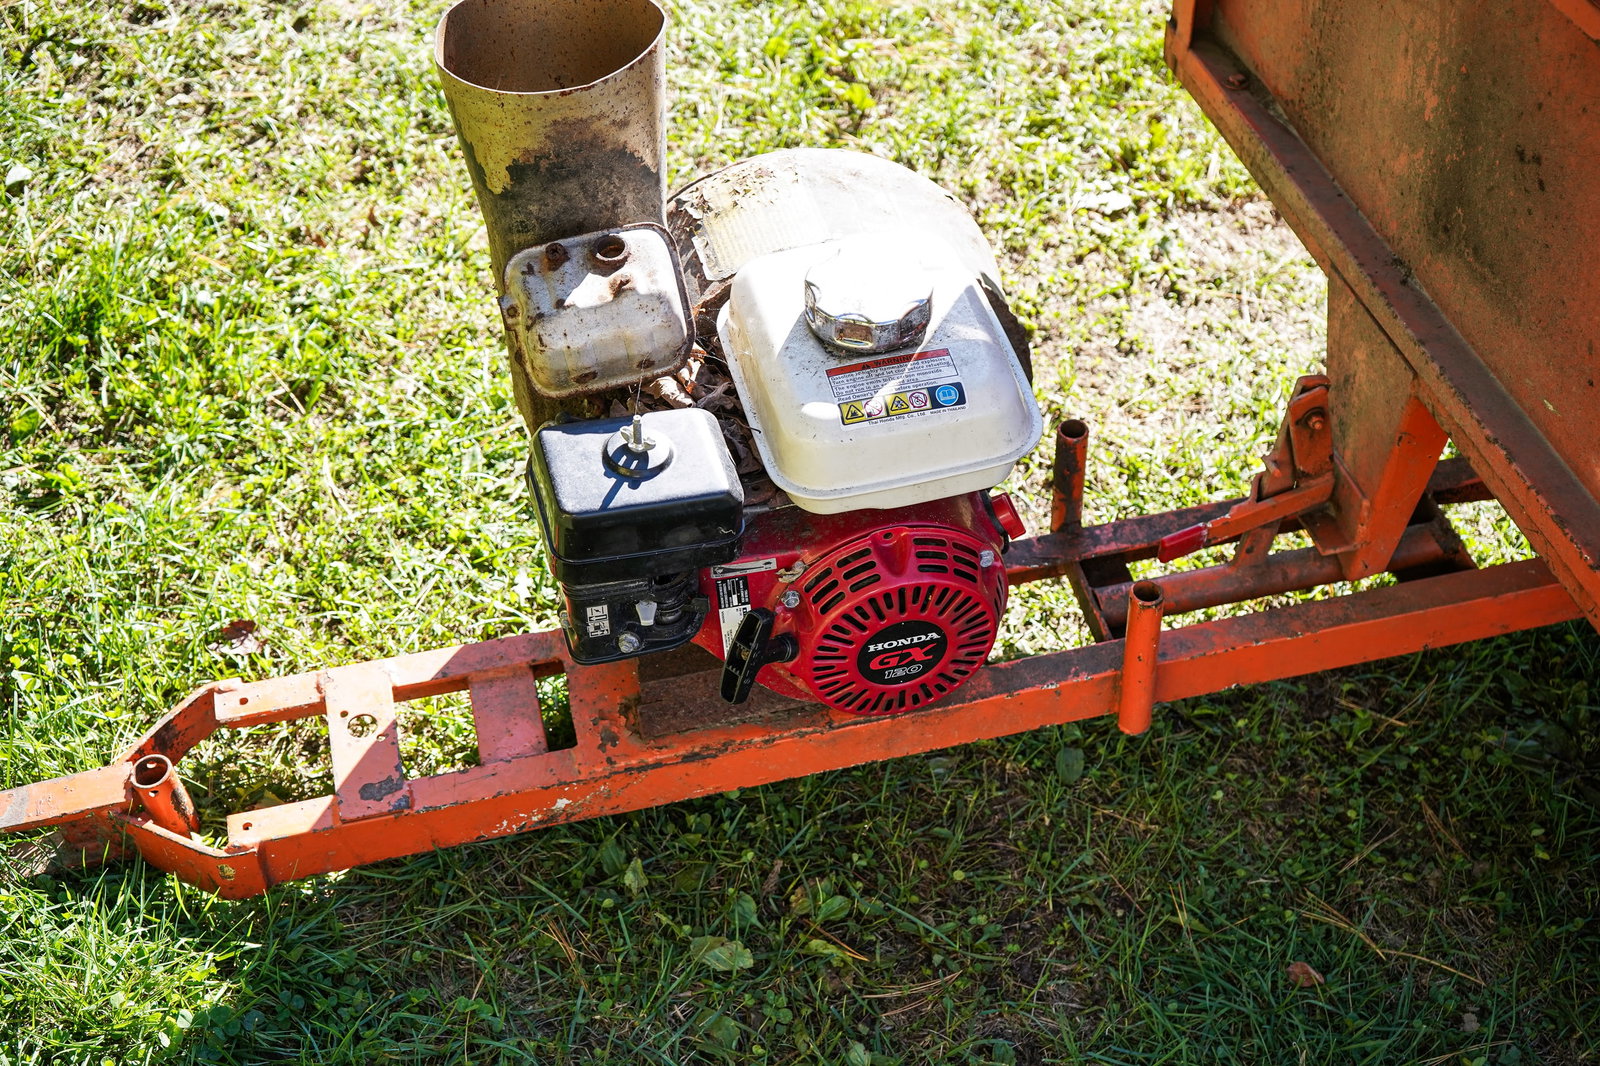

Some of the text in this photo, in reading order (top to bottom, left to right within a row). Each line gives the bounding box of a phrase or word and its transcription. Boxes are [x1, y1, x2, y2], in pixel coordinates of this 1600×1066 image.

[868, 632, 940, 652] HONDA
[870, 643, 936, 670] GX
[884, 664, 922, 679] 120
